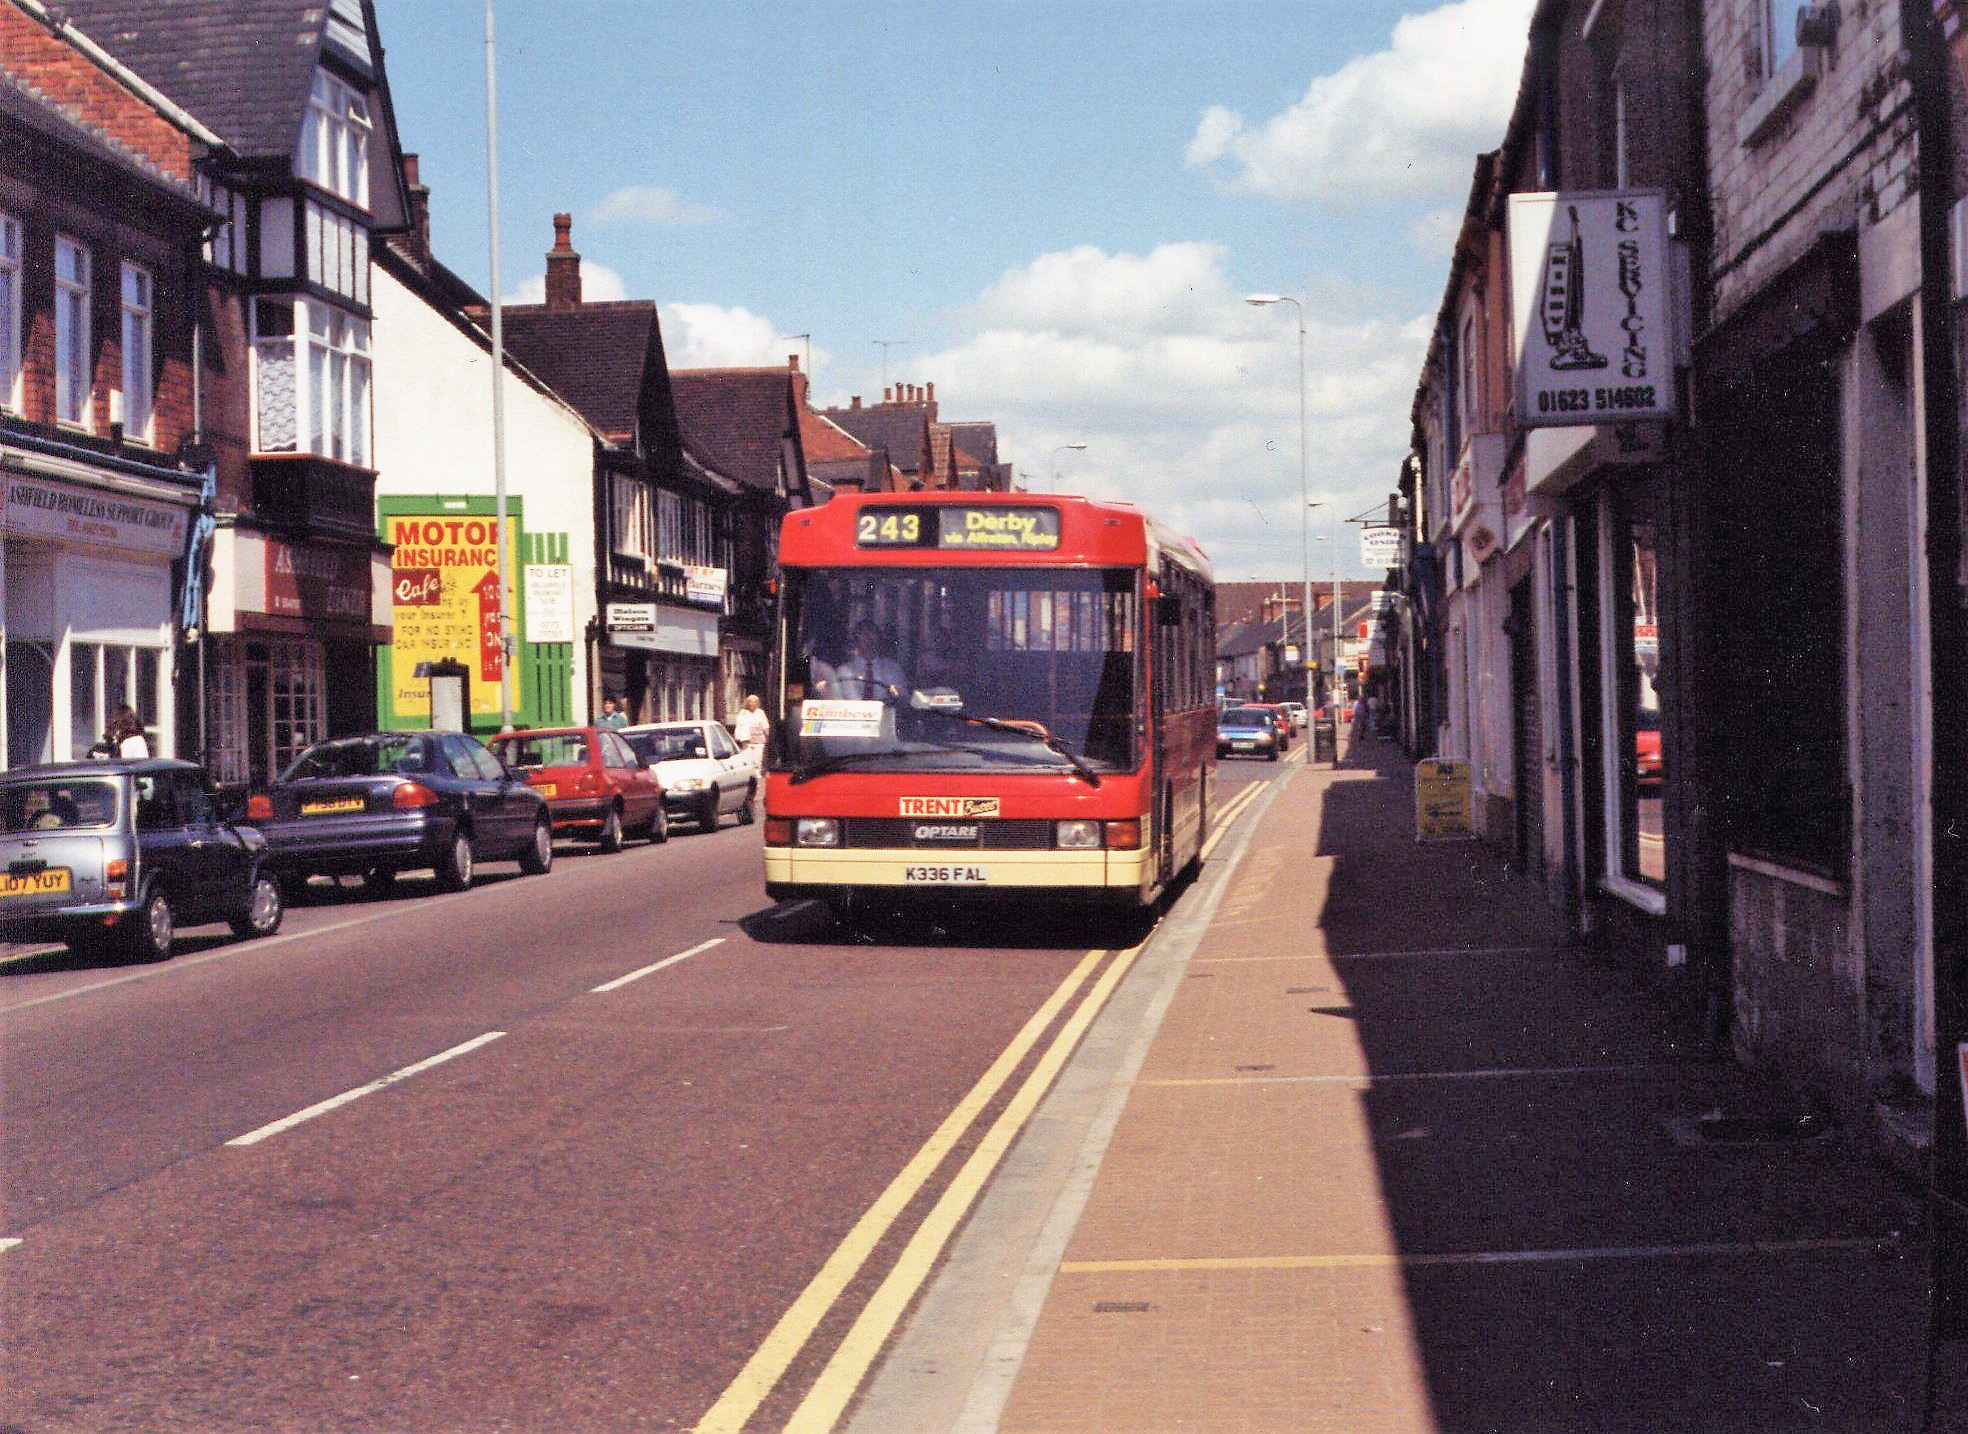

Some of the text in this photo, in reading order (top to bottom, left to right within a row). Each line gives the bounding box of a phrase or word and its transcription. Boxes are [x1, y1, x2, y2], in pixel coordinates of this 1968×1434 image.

[1538, 389, 1590, 412] 01623
[858, 511, 1037, 540] 243 Derby
[530, 568, 566, 578] TO LET
[396, 574, 439, 601] Cafe
[902, 799, 961, 815] TRENT
[915, 826, 978, 839] OPTARE
[906, 868, 985, 881] K336 FAL
